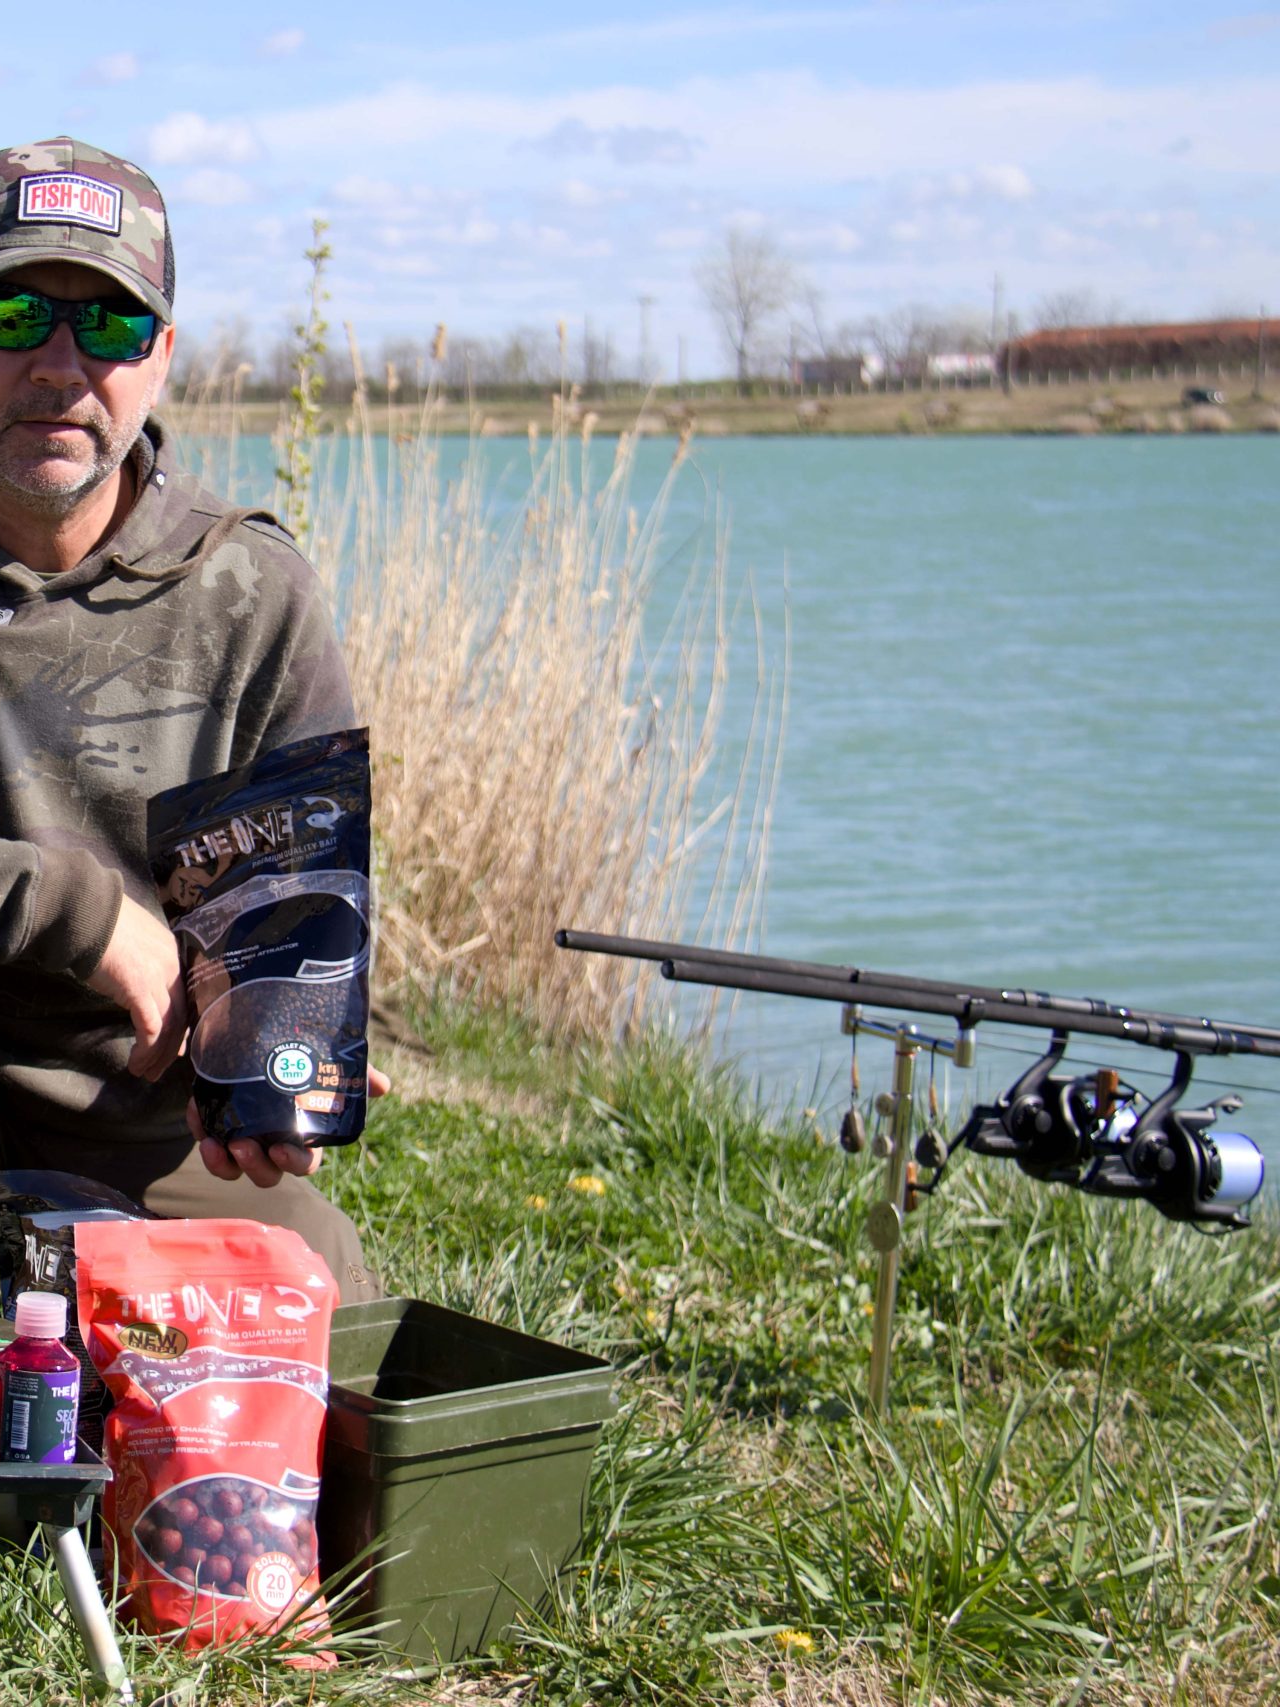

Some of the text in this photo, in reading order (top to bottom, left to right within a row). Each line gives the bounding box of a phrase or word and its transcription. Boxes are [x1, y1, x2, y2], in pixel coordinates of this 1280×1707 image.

[31, 183, 111, 221] FISH-ON!
[175, 803, 294, 868] THE ONE
[283, 842, 317, 858] QUALITY
[318, 836, 338, 848] BAIT
[257, 942, 300, 957] ATTRACTOR
[274, 1042, 312, 1055] PELLET MIX
[279, 1057, 307, 1072] 3-6
[317, 1061, 345, 1077] krill
[282, 1071, 304, 1079] mm
[116, 1282, 262, 1327] THE ONE
[128, 1329, 177, 1348] NEW
[196, 1326, 308, 1341] PREMIUM QUALITY BAIT
[227, 1337, 308, 1348] maximum attraction
[51, 1385, 71, 1398] THE
[175, 1446, 216, 1455] FRIENDLY
[228, 1440, 280, 1449] ATTRACTOR
[265, 1573, 286, 1591] 20
[266, 1590, 285, 1599] mm
